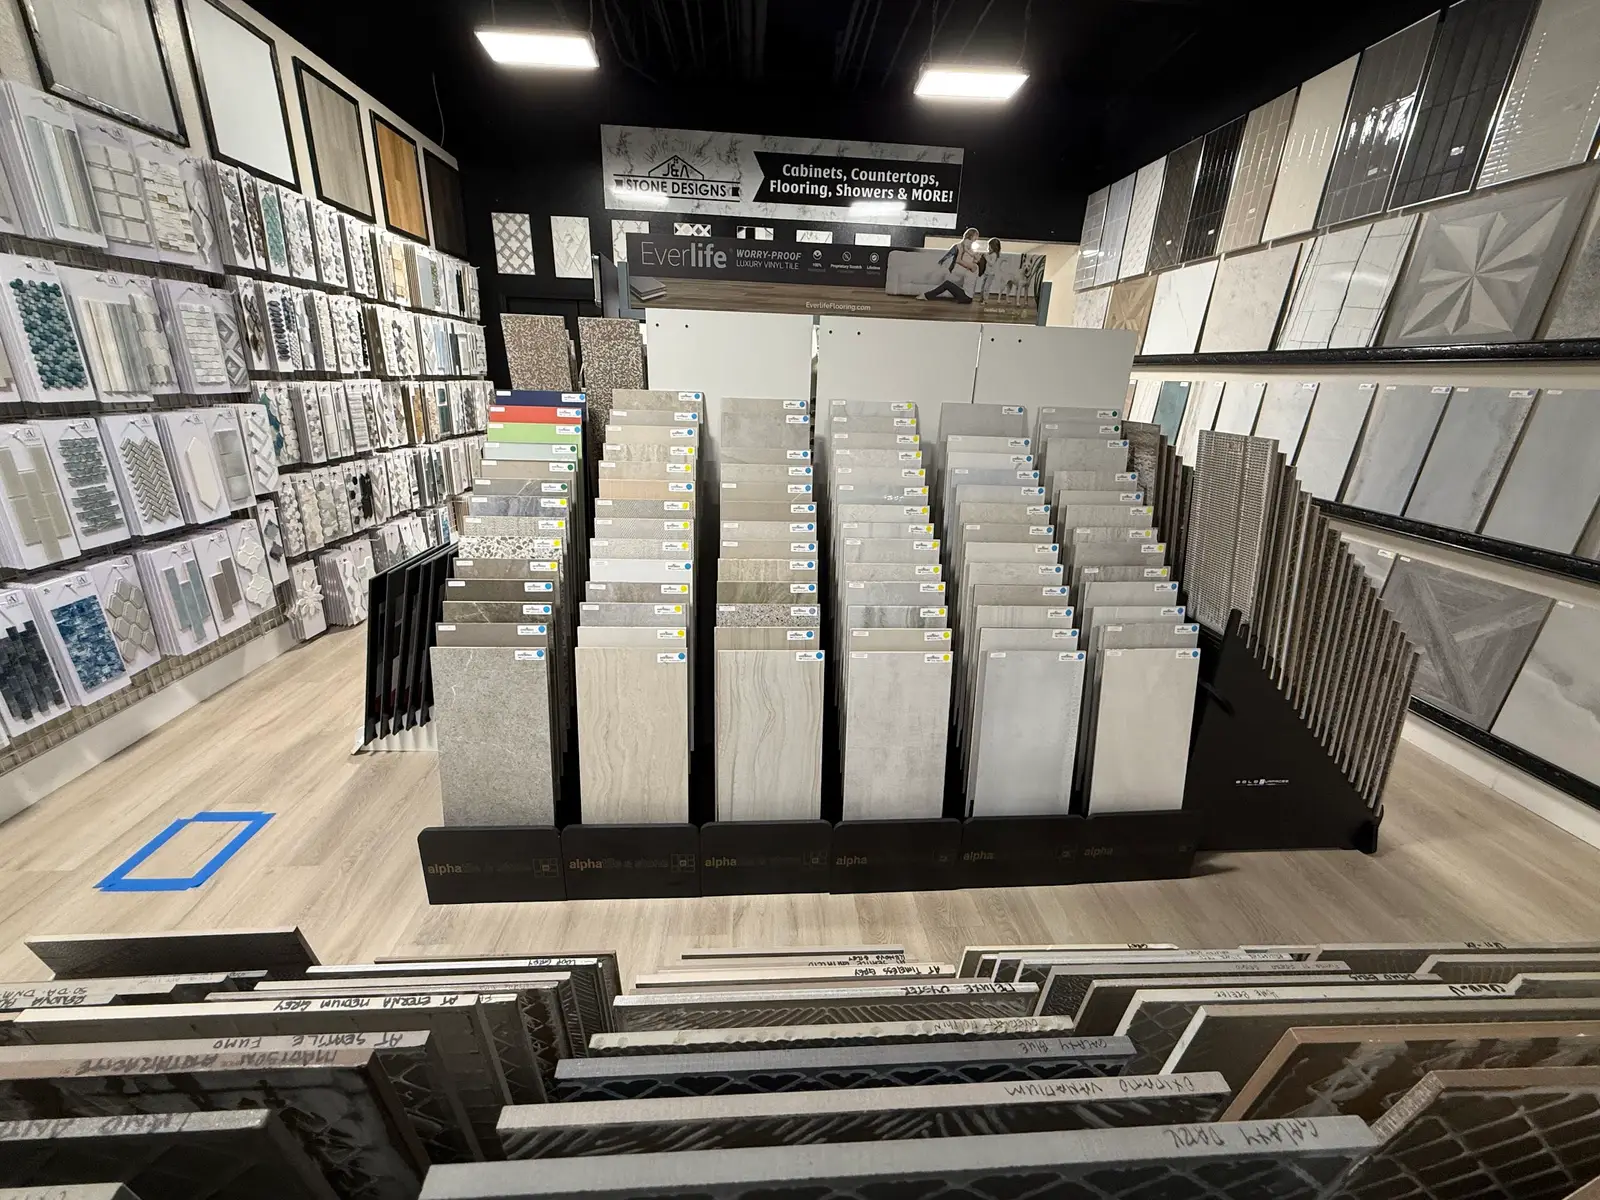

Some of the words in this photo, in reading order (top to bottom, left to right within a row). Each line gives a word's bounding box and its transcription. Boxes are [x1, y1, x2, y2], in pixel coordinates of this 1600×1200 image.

[782, 163, 847, 182] Cabinets,
[851, 167, 940, 187] Countertops,
[626, 179, 667, 193] STONE
[671, 181, 726, 198] DESIGNS
[769, 180, 833, 198] Flooring,
[835, 184, 894, 200] Showers
[897, 187, 908, 200] &
[911, 188, 953, 203] MORE!
[640, 241, 728, 269] Everlife
[736, 249, 802, 261] WORRY-PROOF
[736, 260, 762, 268] LUXURY
[764, 261, 784, 269] VINYL
[785, 262, 799, 270] TILE
[805, 301, 871, 312] EverlifeFlooring.com
[569, 859, 603, 872] alpha
[705, 857, 737, 868] alpha
[836, 856, 868, 867] alpha
[427, 863, 462, 876] alpha
[854, 968, 876, 977] GREY
[882, 966, 921, 976] TIMELESS
[928, 965, 941, 975] AT
[272, 999, 312, 1012] GREY
[319, 998, 370, 1009] MEDIUM
[383, 996, 431, 1009] ETERNA
[440, 995, 459, 1006] AT
[213, 1037, 262, 1049] FUMO
[374, 1032, 403, 1048] AT
[1163, 1127, 1226, 1148] DARK
